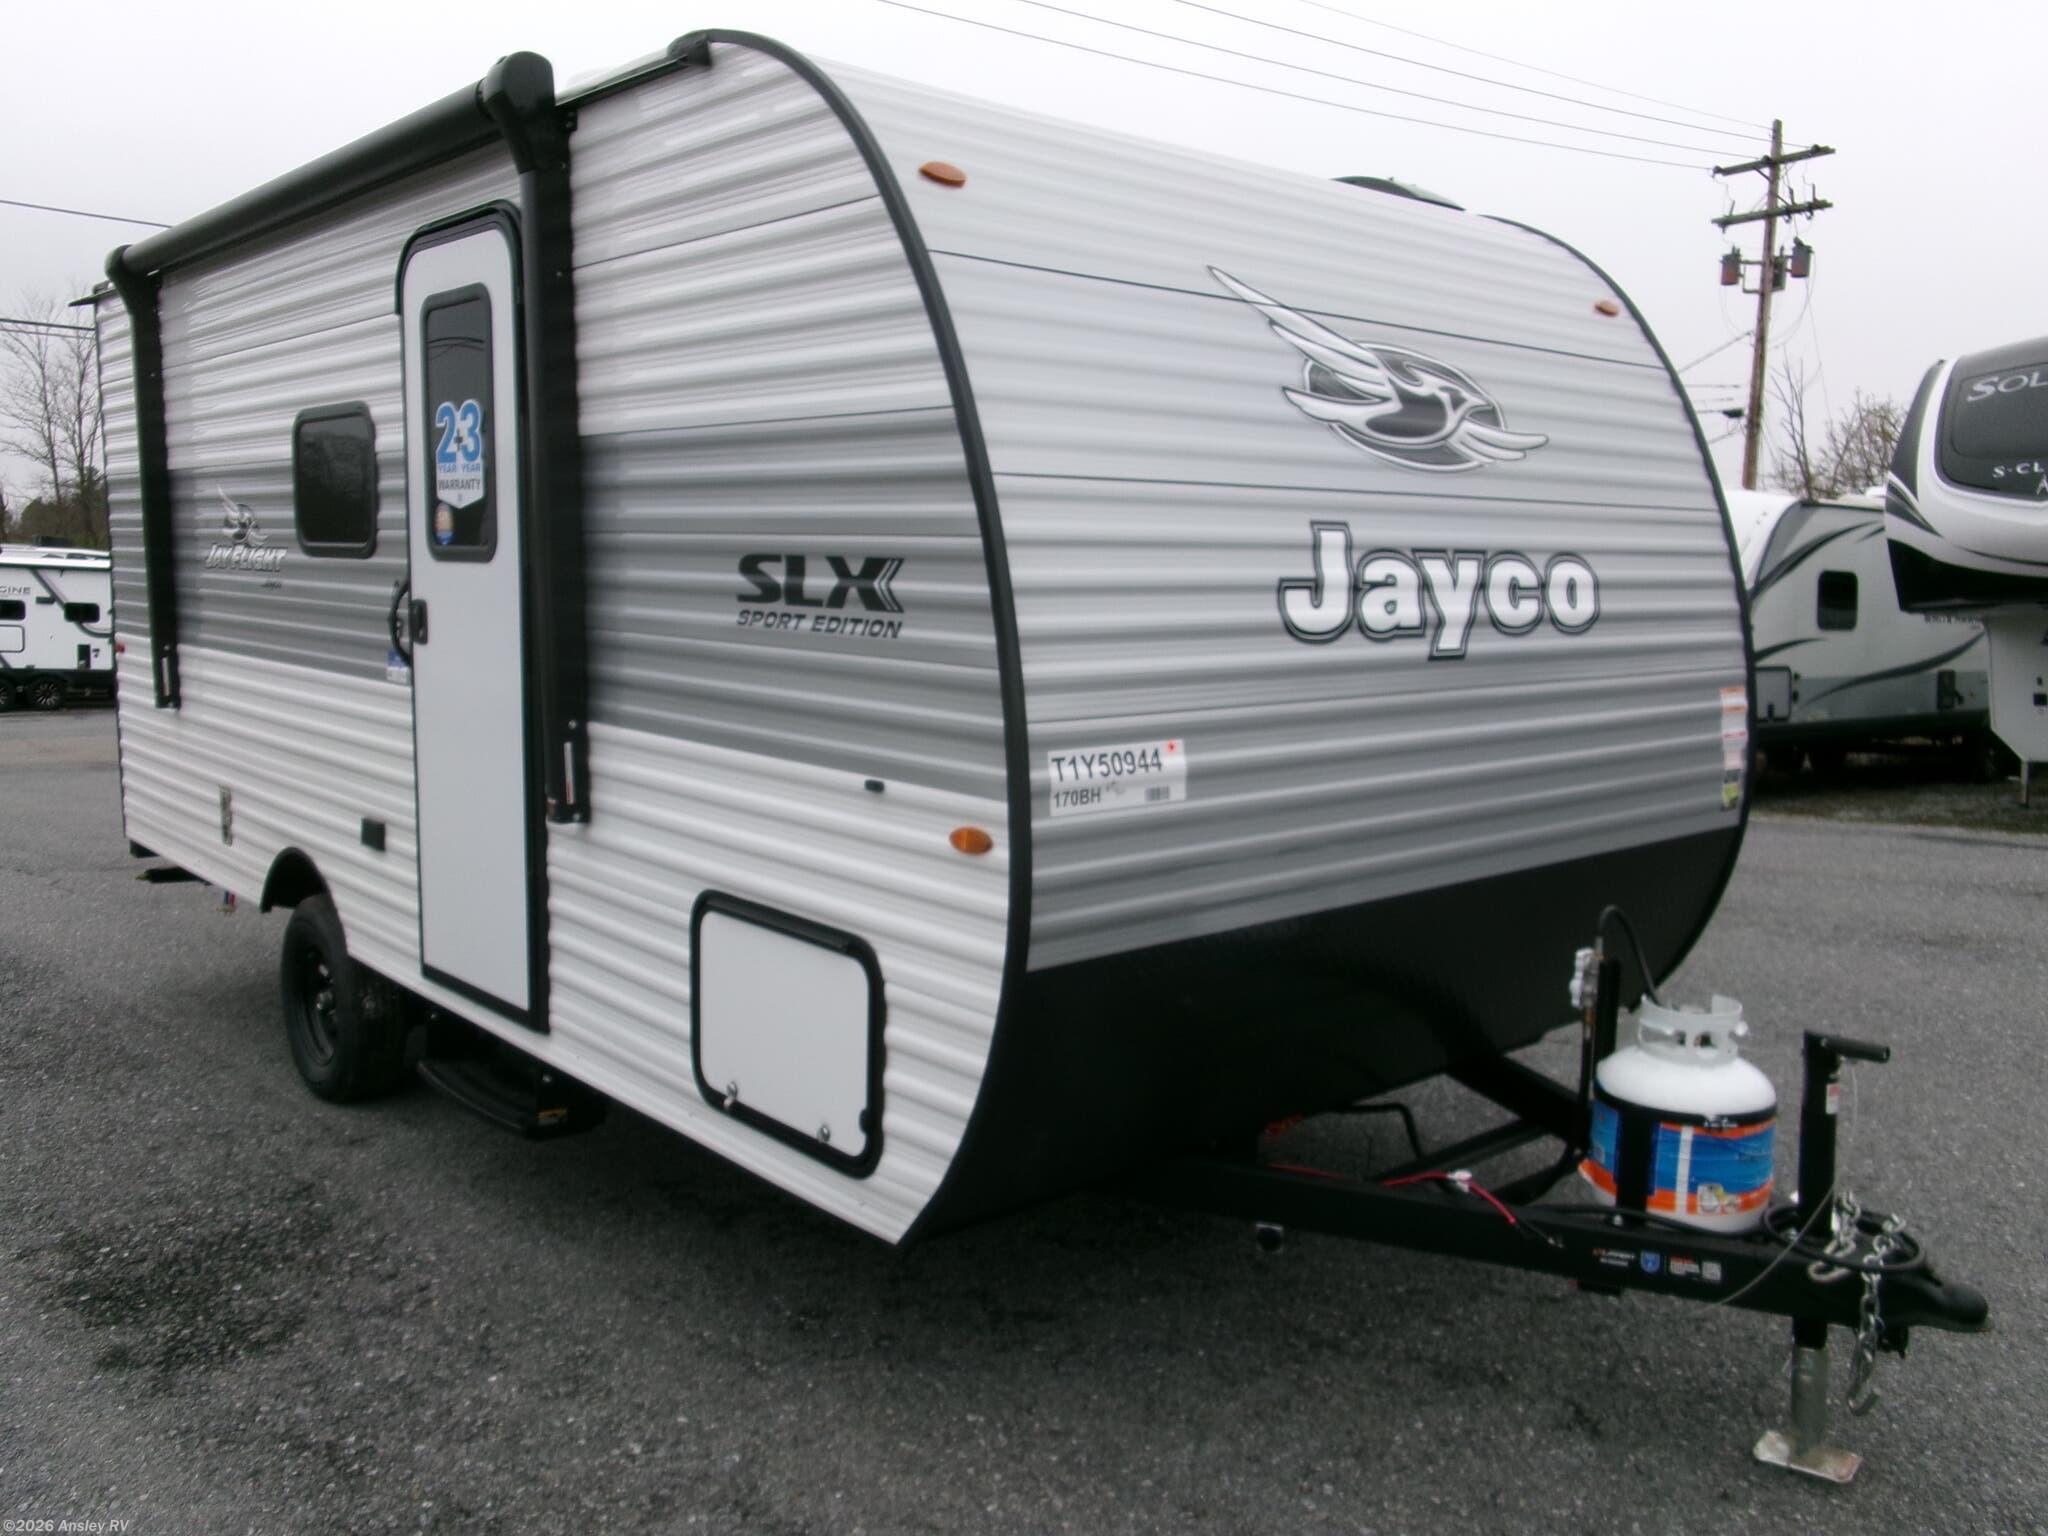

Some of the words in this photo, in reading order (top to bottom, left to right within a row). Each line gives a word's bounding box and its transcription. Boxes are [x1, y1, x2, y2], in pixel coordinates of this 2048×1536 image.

[1965, 371, 2048, 401] SOL
[439, 463, 457, 473] YEAR
[462, 463, 481, 473] YEAR
[437, 479, 481, 491] WARRANTY
[205, 543, 233, 569] JAY
[230, 544, 288, 572] FLIGHT
[737, 554, 904, 613] SLX
[1277, 520, 1600, 661] Jayco
[737, 610, 806, 631] SPORT
[811, 615, 903, 639] EDITION
[1051, 748, 1162, 782] T1Y50944
[1054, 786, 1101, 808] 170BH
